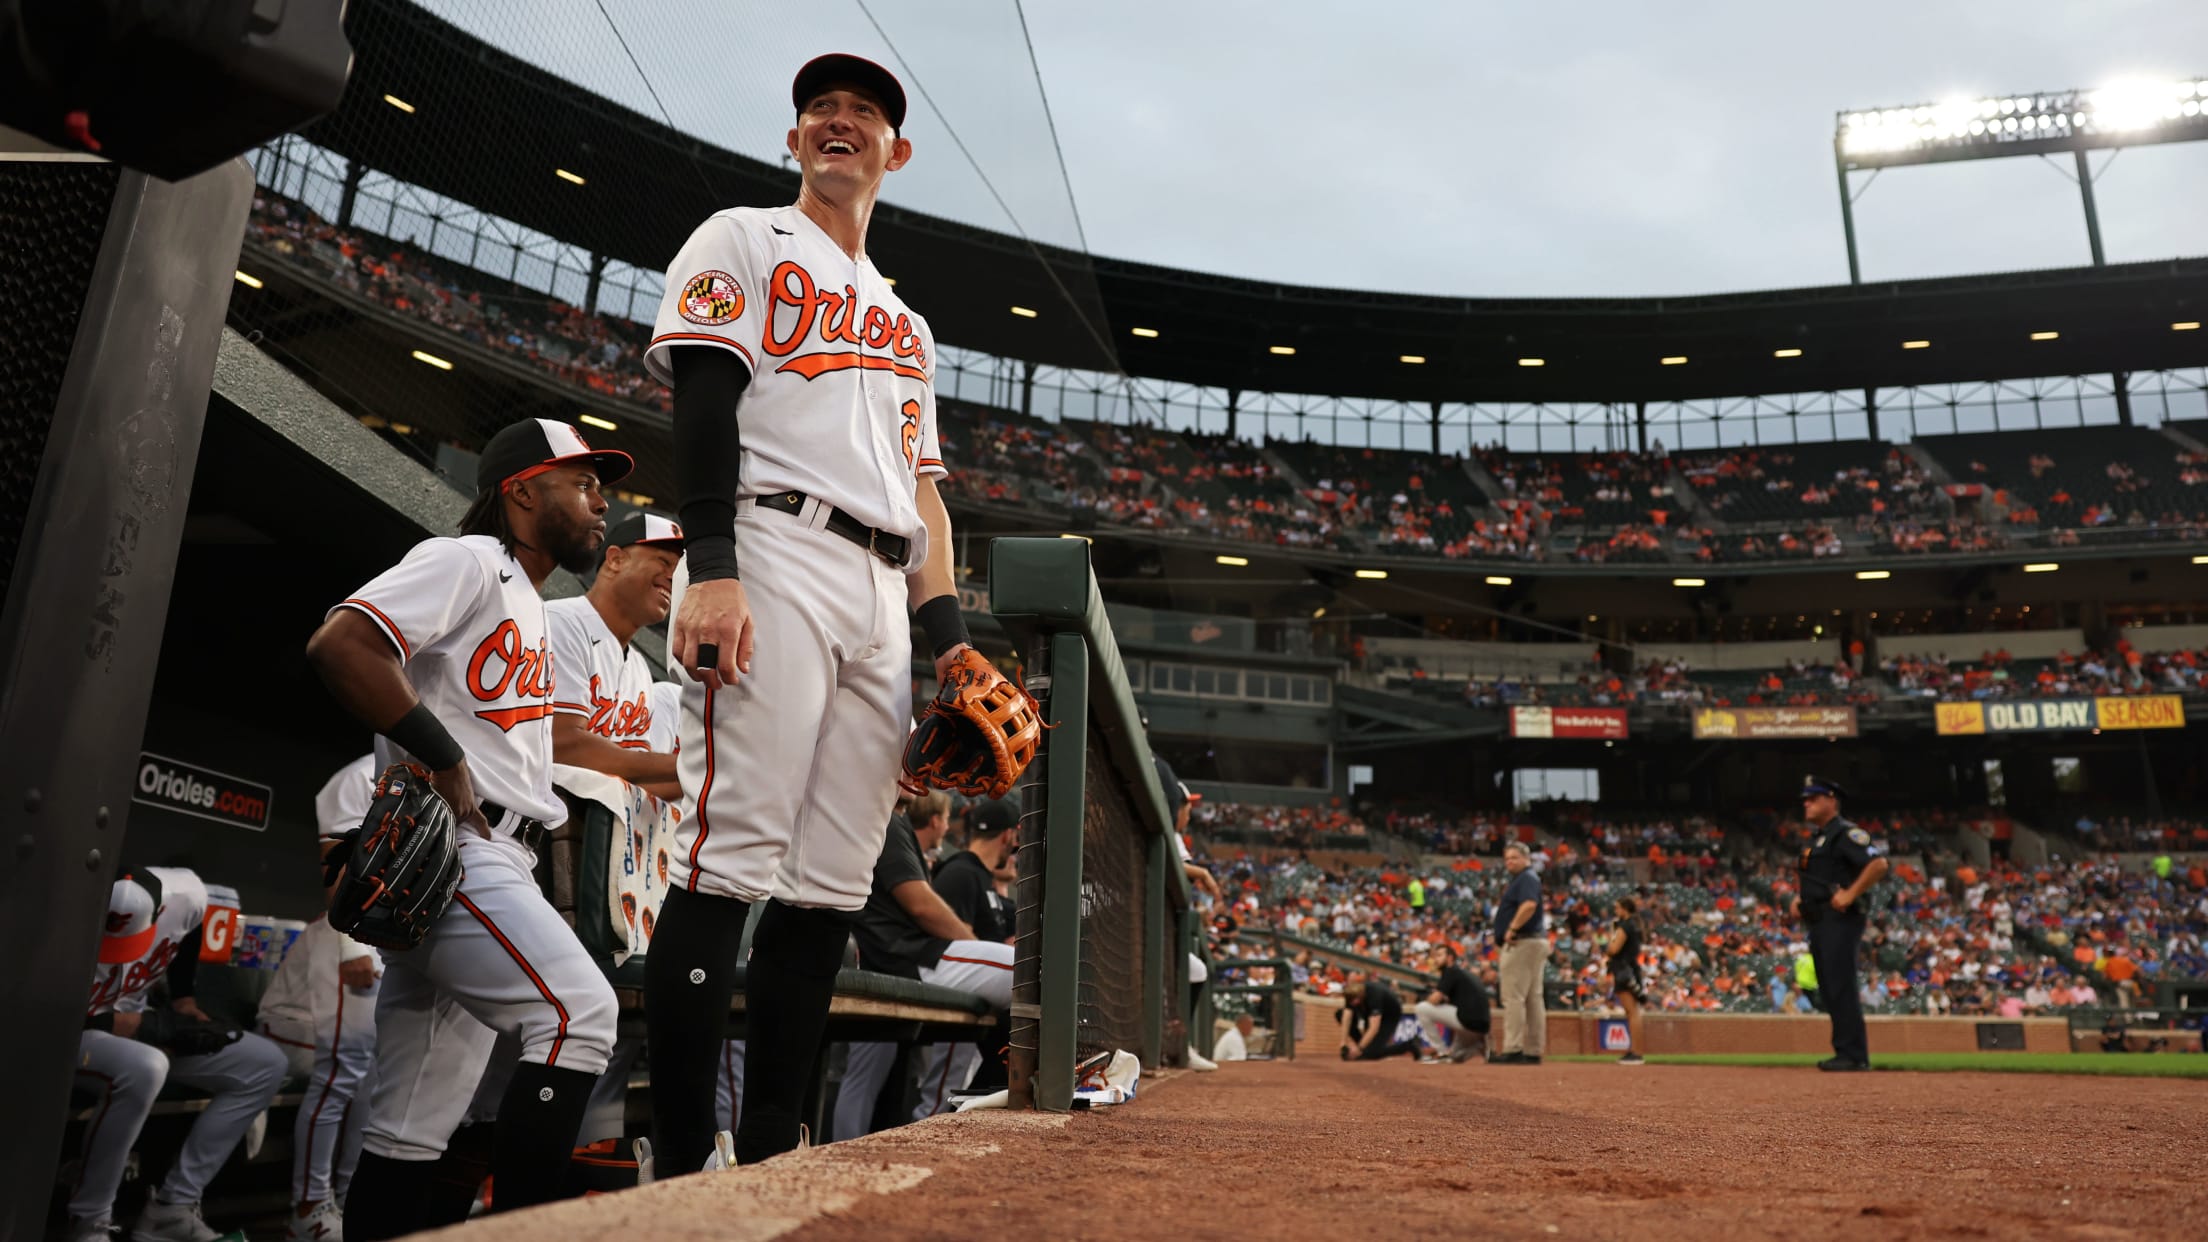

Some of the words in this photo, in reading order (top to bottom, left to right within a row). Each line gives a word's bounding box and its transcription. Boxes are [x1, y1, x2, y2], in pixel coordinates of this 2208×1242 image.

[685, 270, 742, 294] BALTIMORE
[684, 310, 731, 325] ORIOLES
[762, 261, 927, 369] Oriole
[1989, 703, 2037, 730] OLD
[2041, 702, 2089, 727] BAY
[2104, 700, 2177, 725] SEASON
[139, 763, 265, 821] Orioles.com
[206, 910, 230, 952] G
